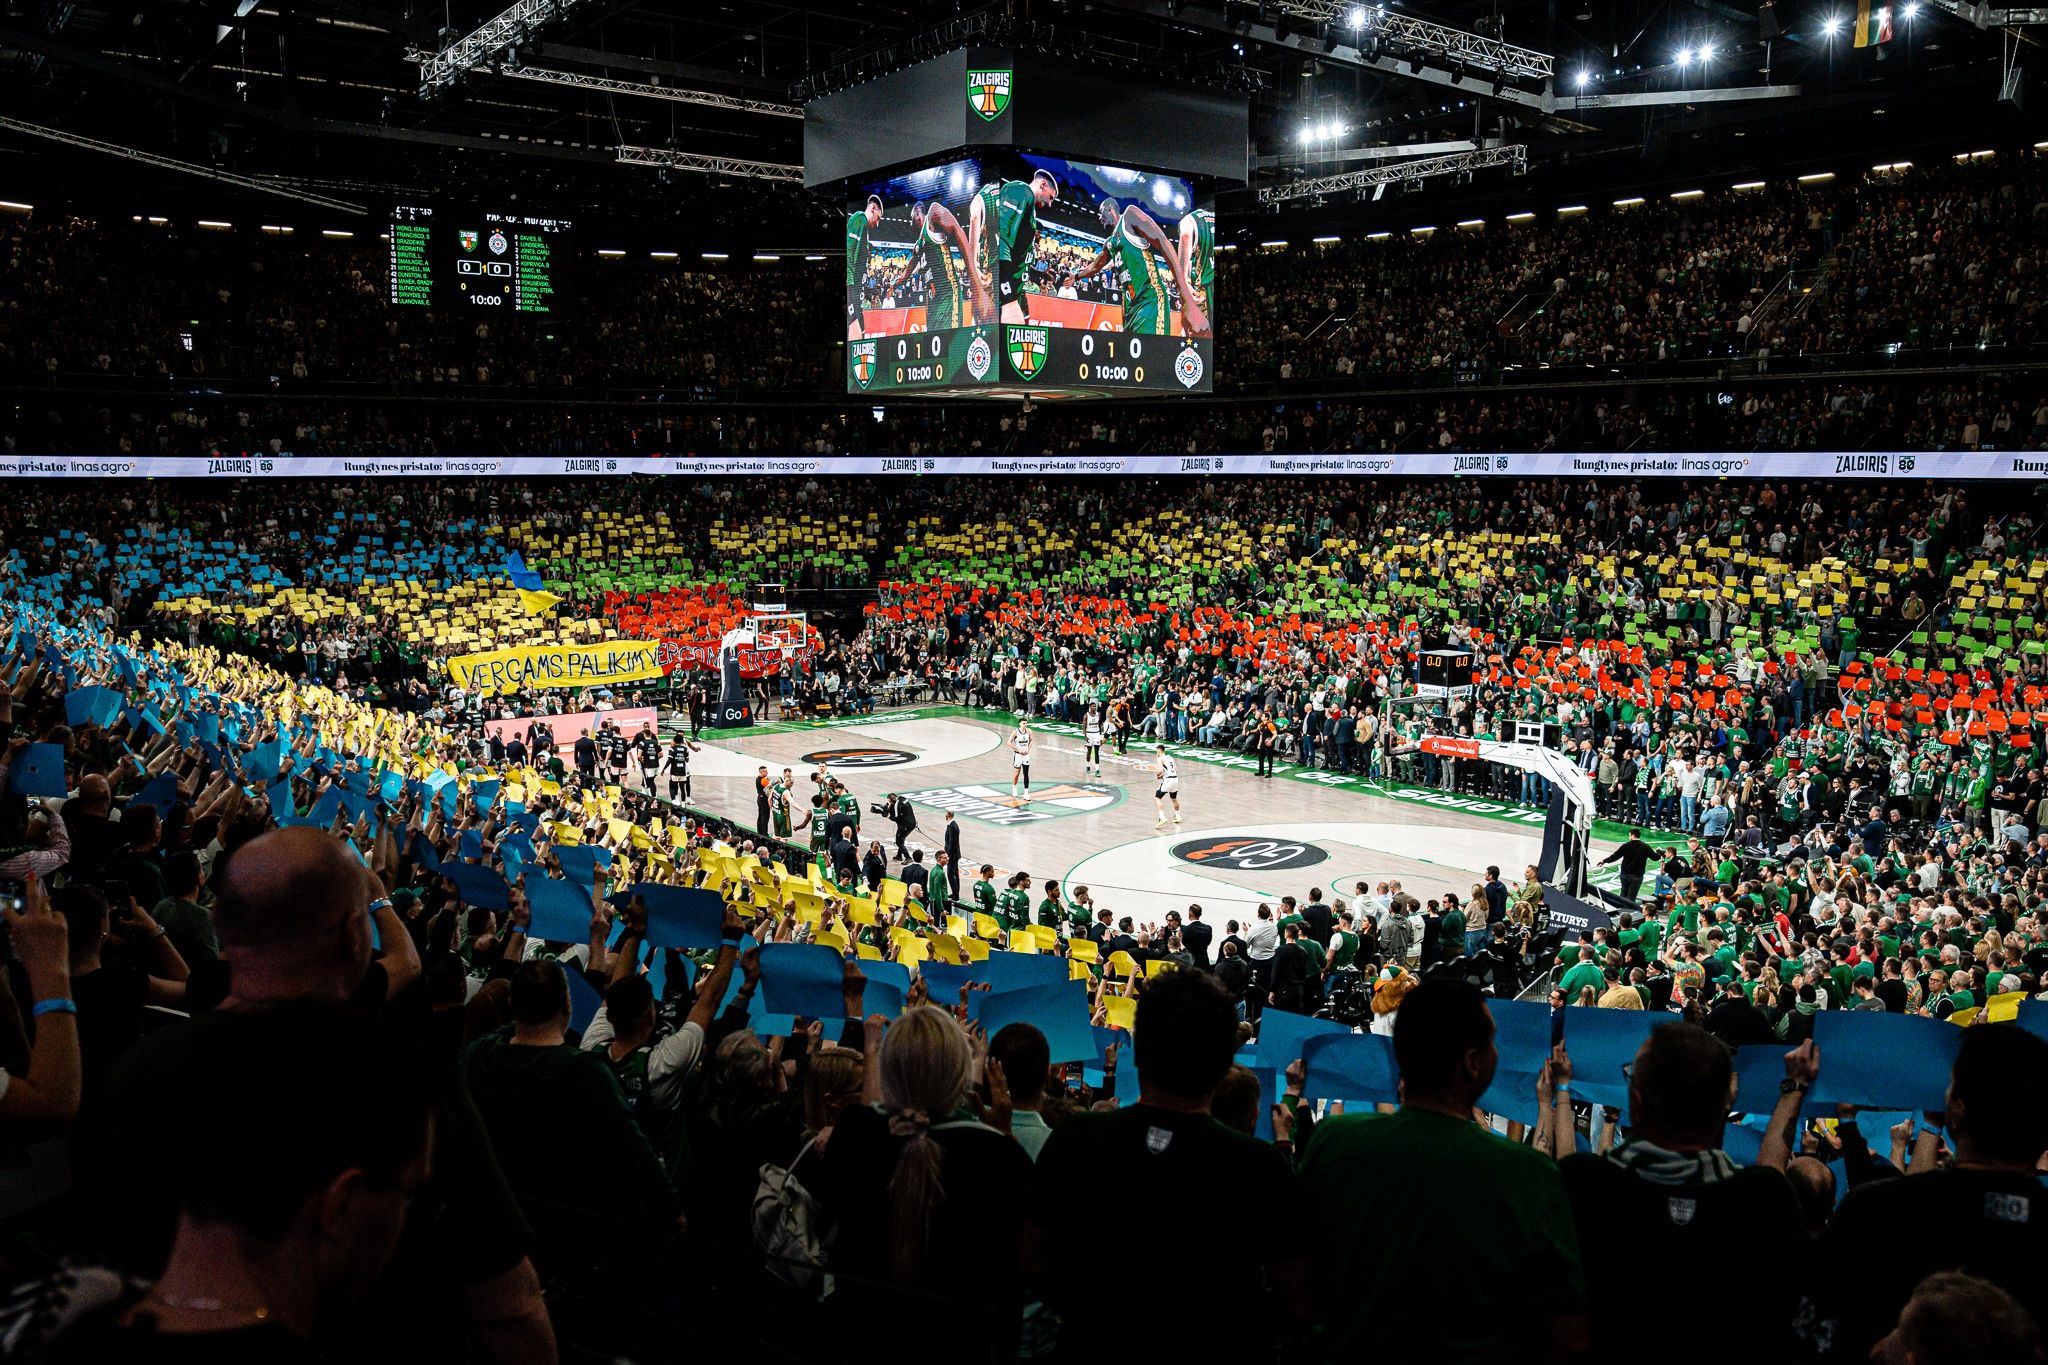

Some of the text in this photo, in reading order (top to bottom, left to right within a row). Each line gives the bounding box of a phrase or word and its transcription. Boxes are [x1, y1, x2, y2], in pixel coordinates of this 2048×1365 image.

[463, 262, 501, 274] 0 1 0
[470, 295, 501, 305] 10:00
[898, 336, 940, 360] 0 1 0
[1082, 335, 1142, 358] 0 1 0
[896, 364, 943, 383] 0 10:00 0
[1080, 364, 1144, 382] 0 10:00 0
[18, 462, 66, 474] pristato:
[71, 462, 99, 472] linas
[101, 464, 130, 474] agro
[344, 462, 496, 473] Rungtynes pristato: linas agro
[676, 462, 816, 472] Rungtynes pristato: linas agro
[992, 461, 1120, 472] Rungtynes pristato: linas agro
[1270, 460, 1389, 471] Rungtynes pristato: linas agro
[1574, 459, 1742, 473] Rungtynes pristato: linas agro
[1427, 656, 1441, 666] 0.0
[1456, 656, 1468, 667] 0.0
[461, 653, 563, 689] VERGAMS
[568, 647, 646, 677] PALIKIM
[1397, 789, 1547, 823] ALGIRIS
[818, 821, 825, 831] 3
[1550, 910, 1589, 928] YTURYS
